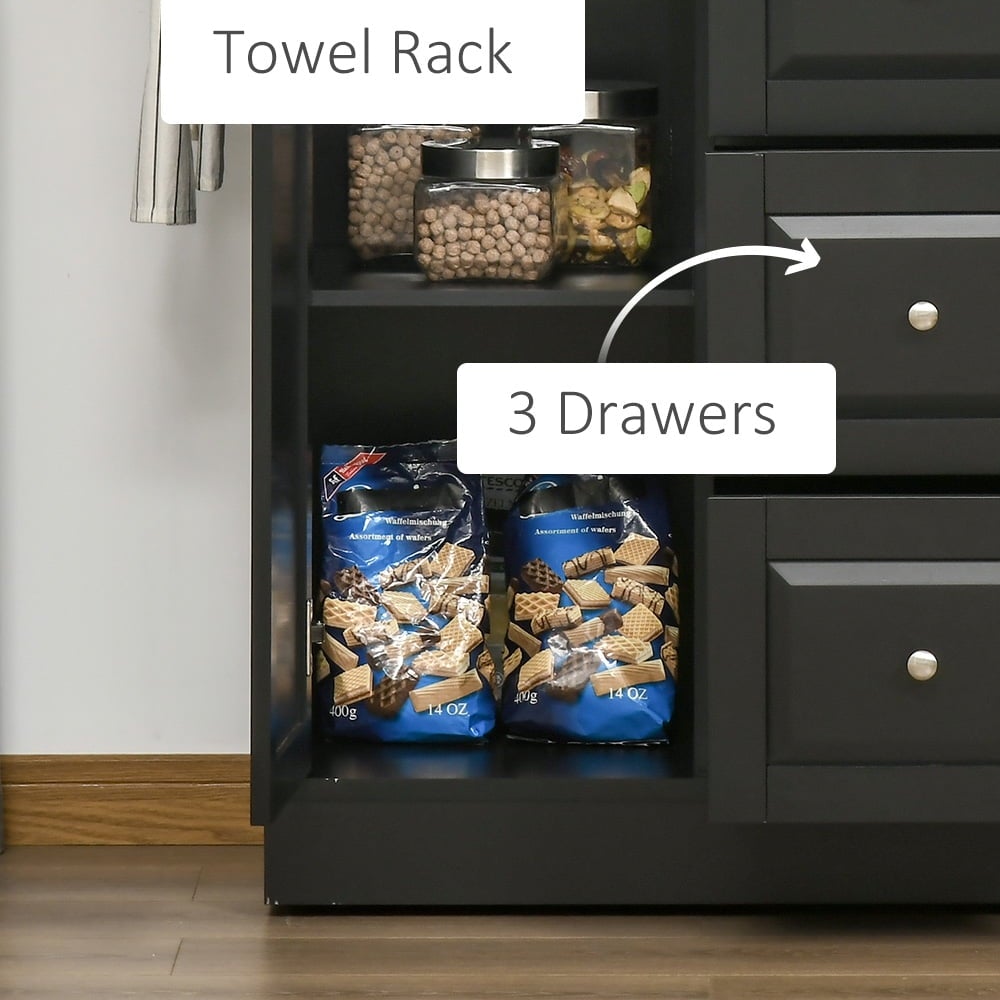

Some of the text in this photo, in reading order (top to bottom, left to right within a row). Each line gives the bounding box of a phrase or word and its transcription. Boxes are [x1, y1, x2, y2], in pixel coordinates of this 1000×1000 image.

[395, 533, 405, 541] of
[534, 528, 579, 536] Assortment
[590, 526, 617, 534] wafers
[609, 686, 649, 701] 14 OZ
[329, 703, 357, 721] 400g
[427, 702, 469, 716] 14 OZ
